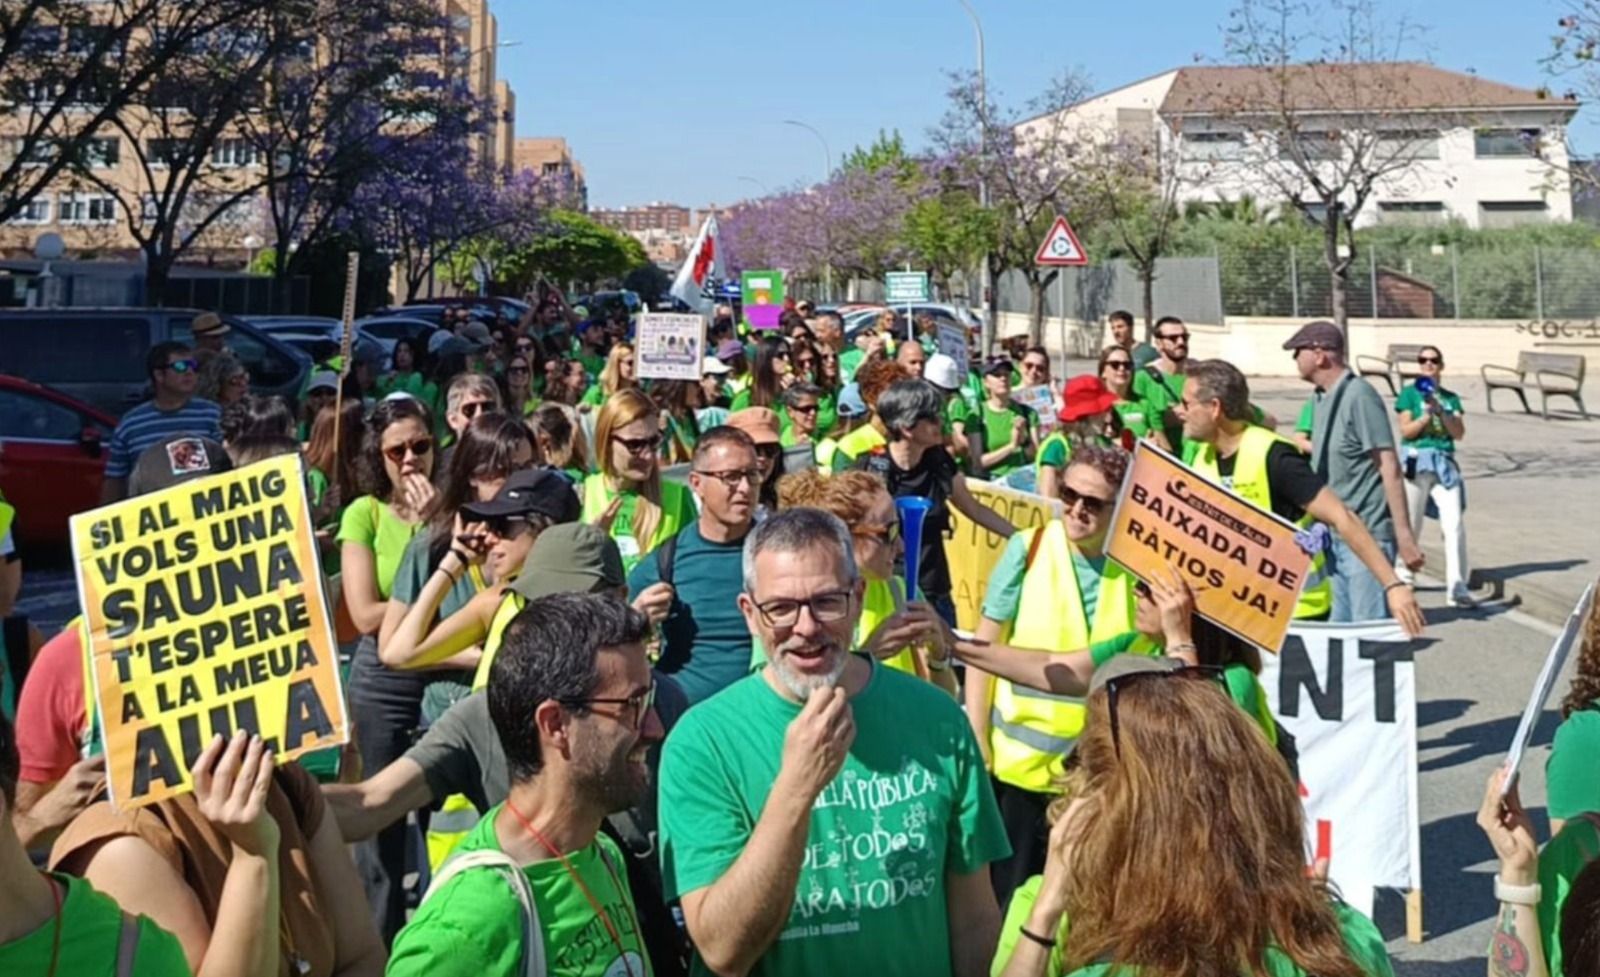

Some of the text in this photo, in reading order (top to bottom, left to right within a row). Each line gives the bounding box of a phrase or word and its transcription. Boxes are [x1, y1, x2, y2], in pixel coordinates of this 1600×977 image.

[90, 469, 287, 551] SI AL MAIG
[96, 504, 294, 586] VOLS UNA
[1131, 484, 1298, 591] BAIXADA DE
[102, 541, 304, 640] SAUNA
[1127, 518, 1279, 618] RÀTIOS JA!
[112, 593, 311, 684] T'ESPERE
[1278, 634, 1414, 723] NT
[121, 640, 318, 725] A LA MEUA
[857, 769, 938, 811] PÚBLICA
[789, 887, 846, 922] ARA
